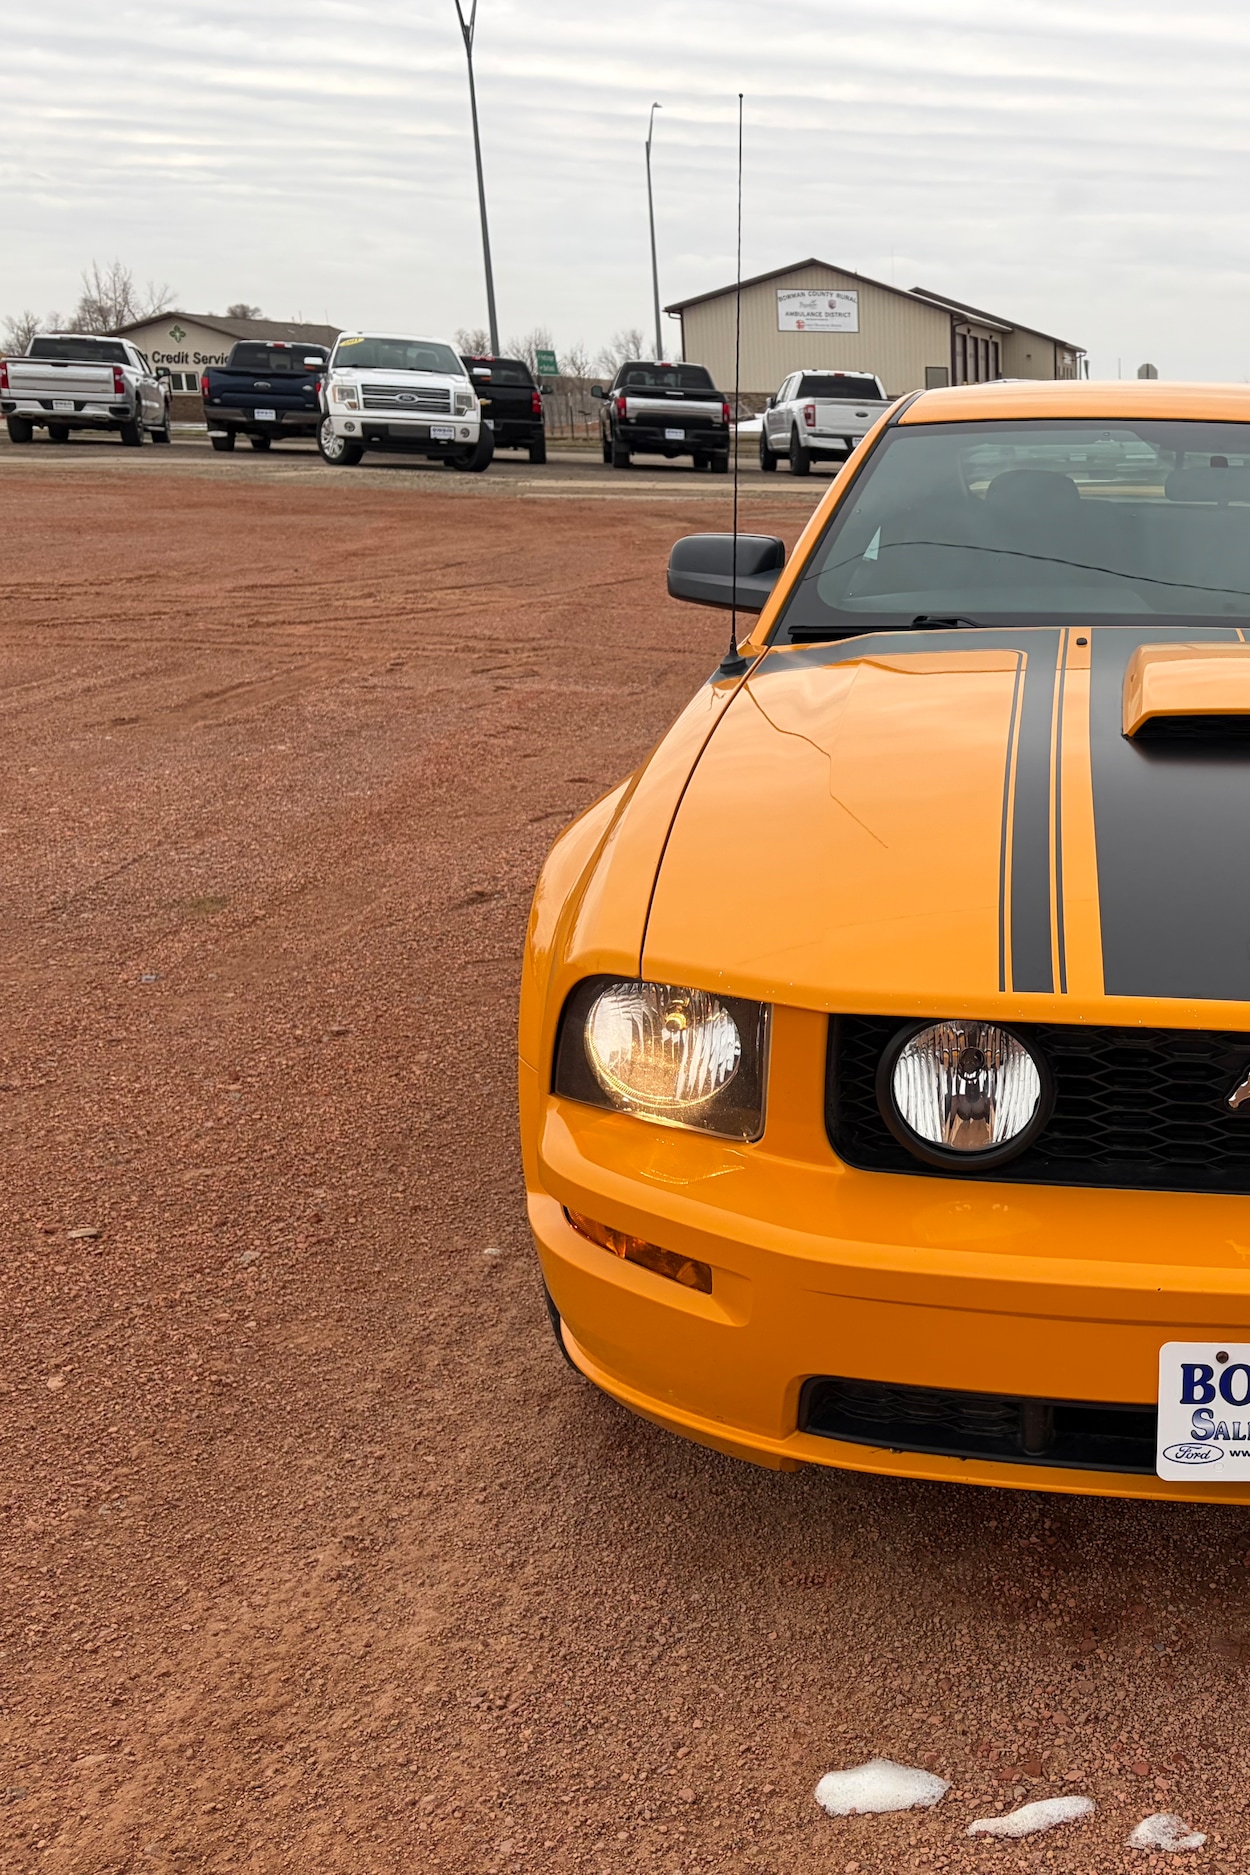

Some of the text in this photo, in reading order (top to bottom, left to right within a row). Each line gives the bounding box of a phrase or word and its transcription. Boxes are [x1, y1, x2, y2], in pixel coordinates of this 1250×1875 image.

[778, 291, 806, 302] BOWMAN
[808, 290, 835, 298] COUNTY
[151, 350, 190, 365] Credit
[192, 351, 230, 365] Servic
[1174, 1445, 1212, 1460] Ford
